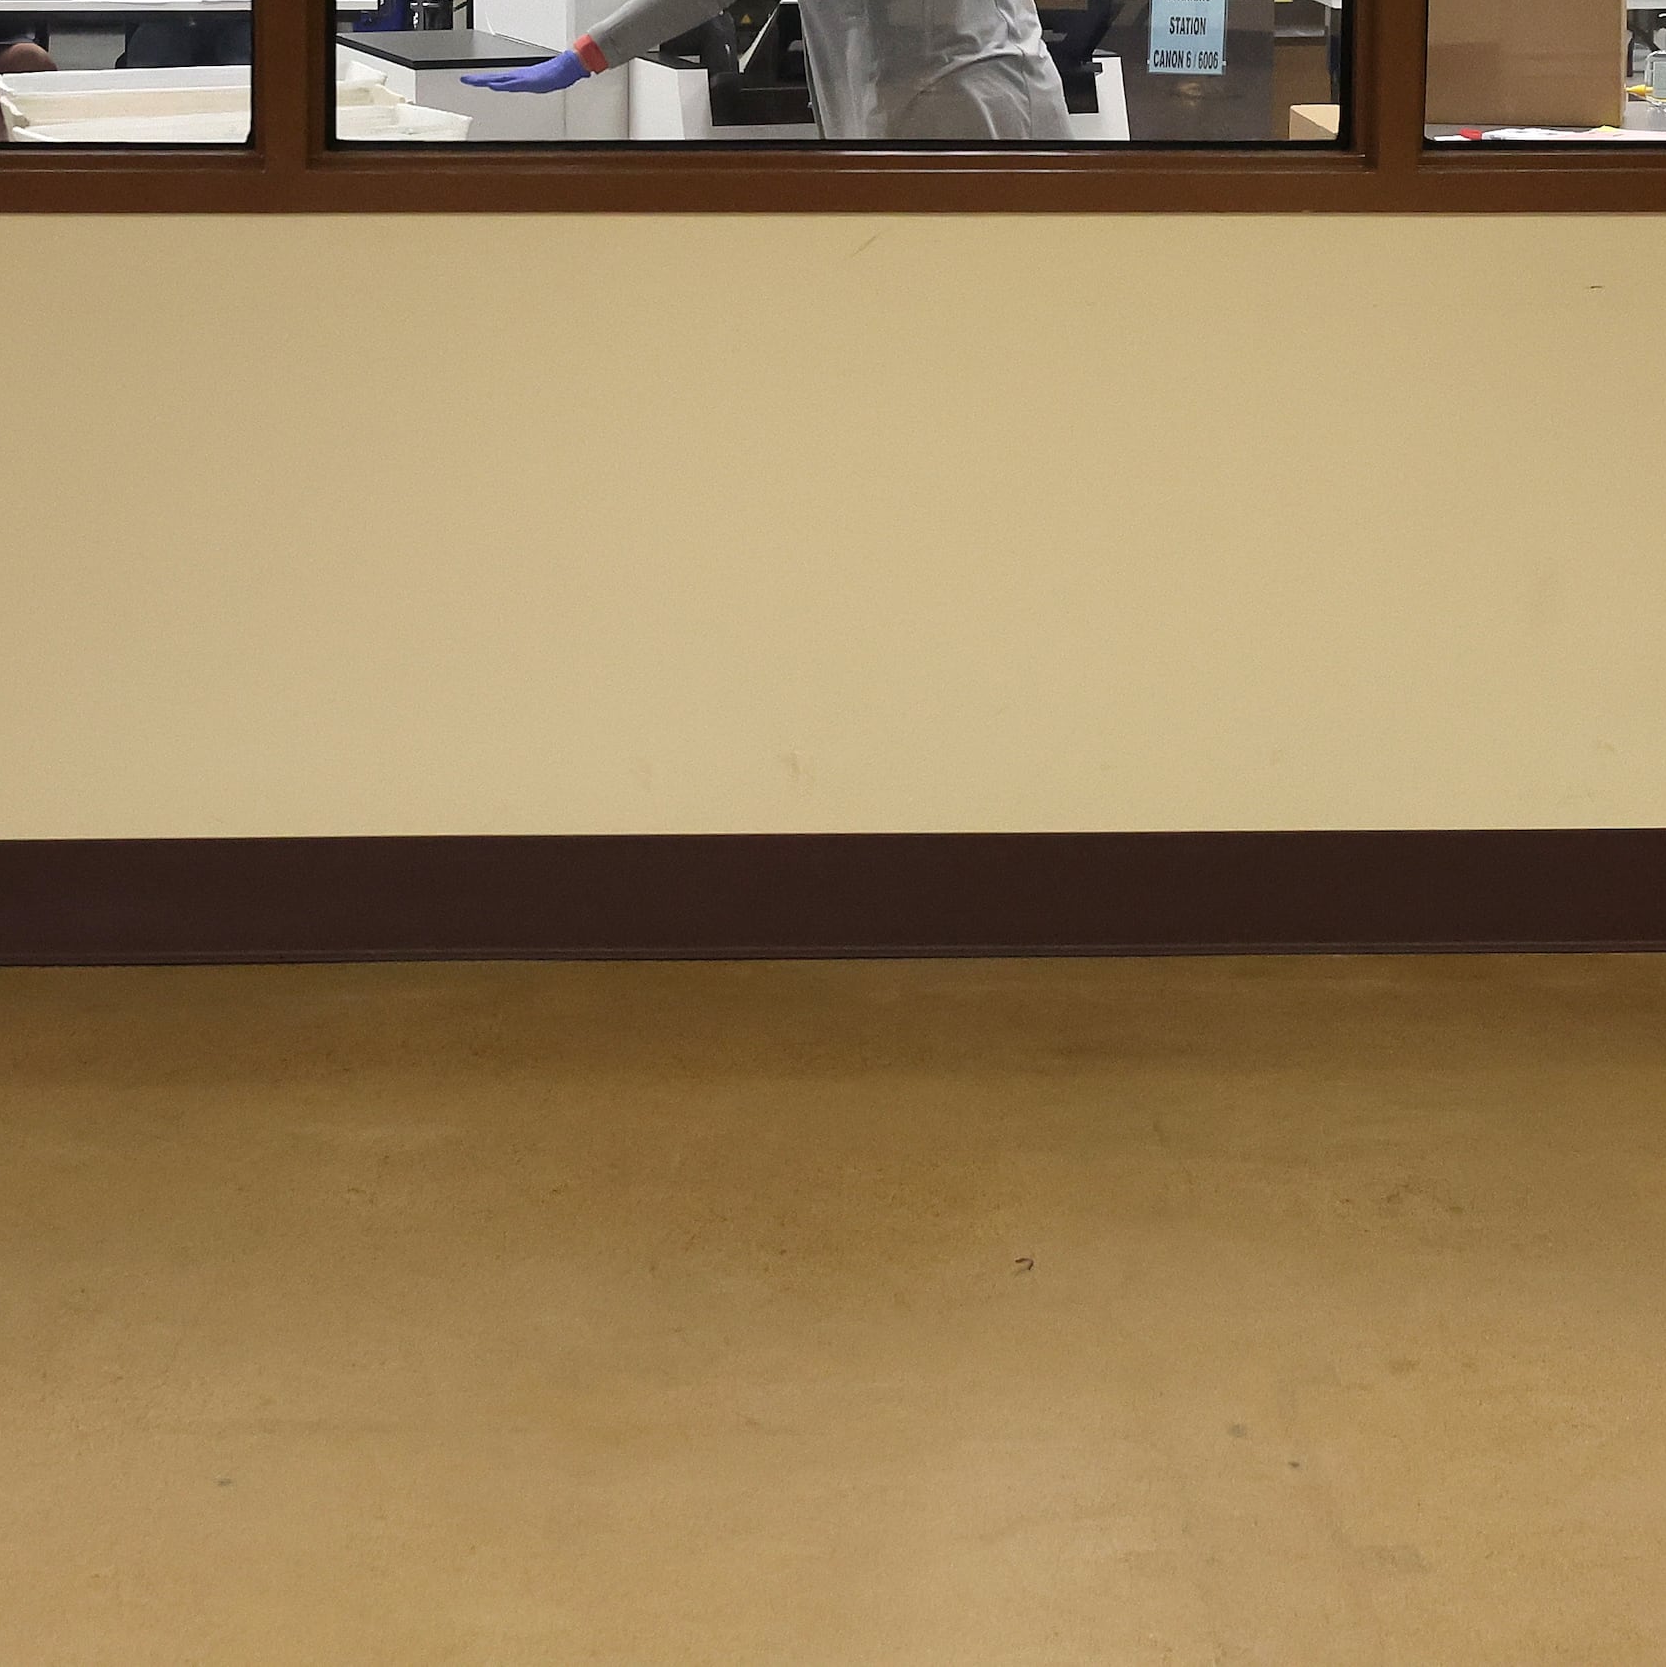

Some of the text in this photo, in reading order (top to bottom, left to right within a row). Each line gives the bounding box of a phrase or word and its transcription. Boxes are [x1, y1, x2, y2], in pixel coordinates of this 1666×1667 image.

[1169, 16, 1206, 35] STATION
[1154, 50, 1184, 68] CANON
[1186, 51, 1191, 68] 6
[1198, 51, 1218, 70] 6006
